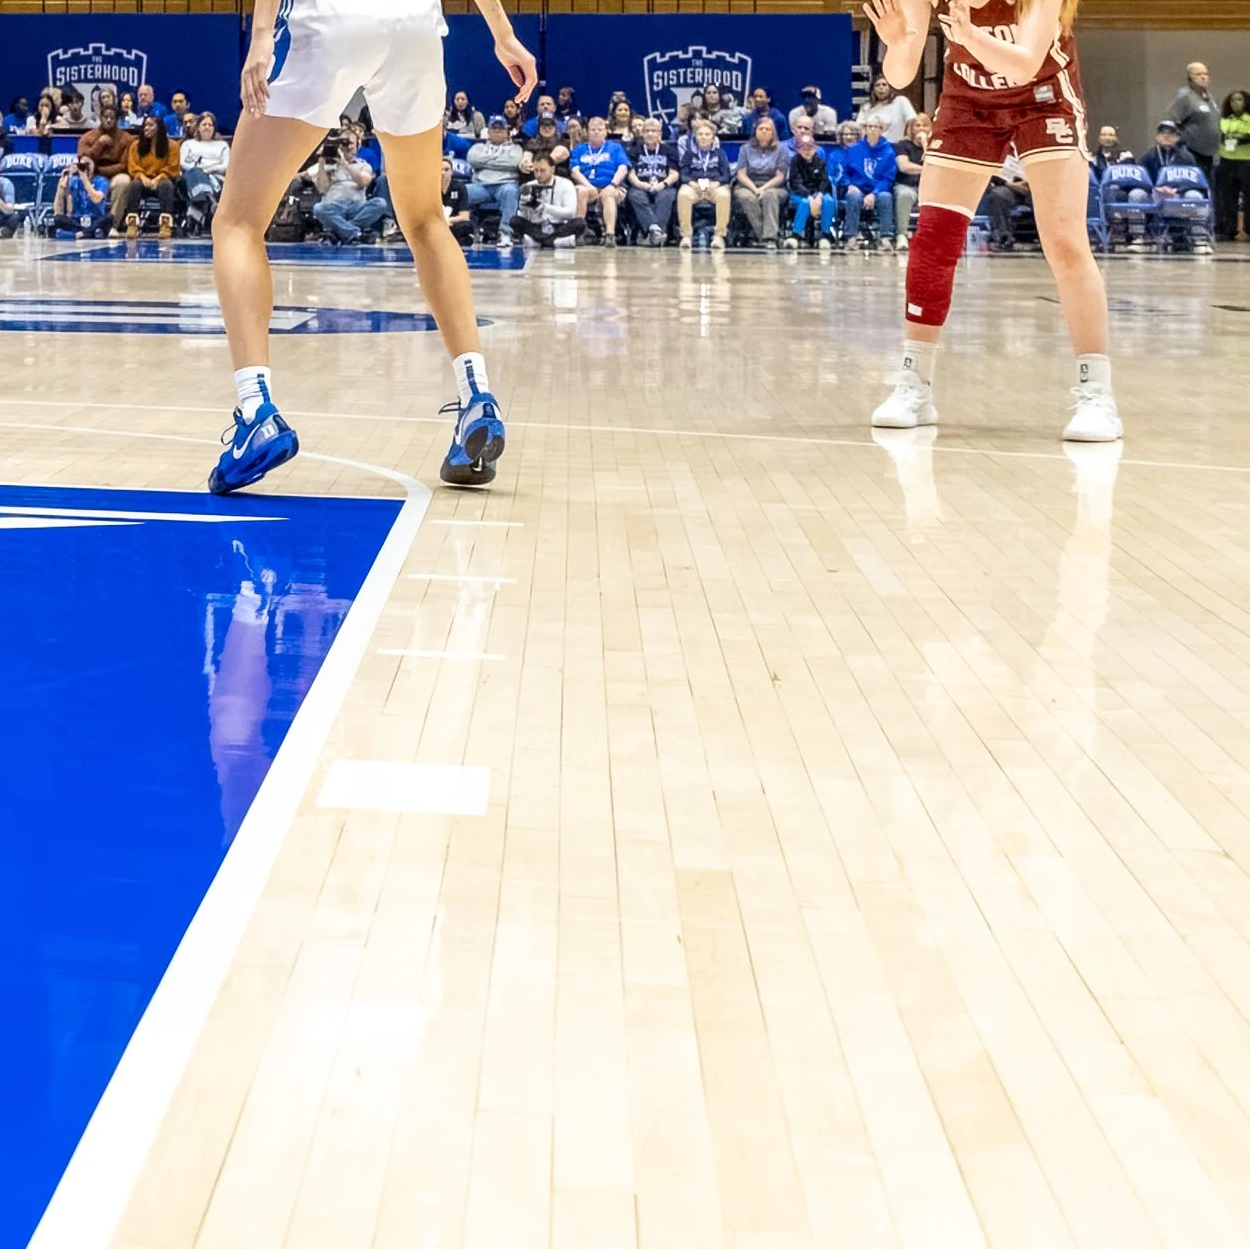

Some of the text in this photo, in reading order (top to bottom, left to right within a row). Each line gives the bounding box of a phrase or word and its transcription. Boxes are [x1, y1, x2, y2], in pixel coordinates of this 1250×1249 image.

[56, 63, 138, 87] SISTERHOOD
[653, 67, 742, 91] SISTERHOOD
[1111, 166, 1143, 181] DUKE
[1166, 167, 1199, 182] DUKE
